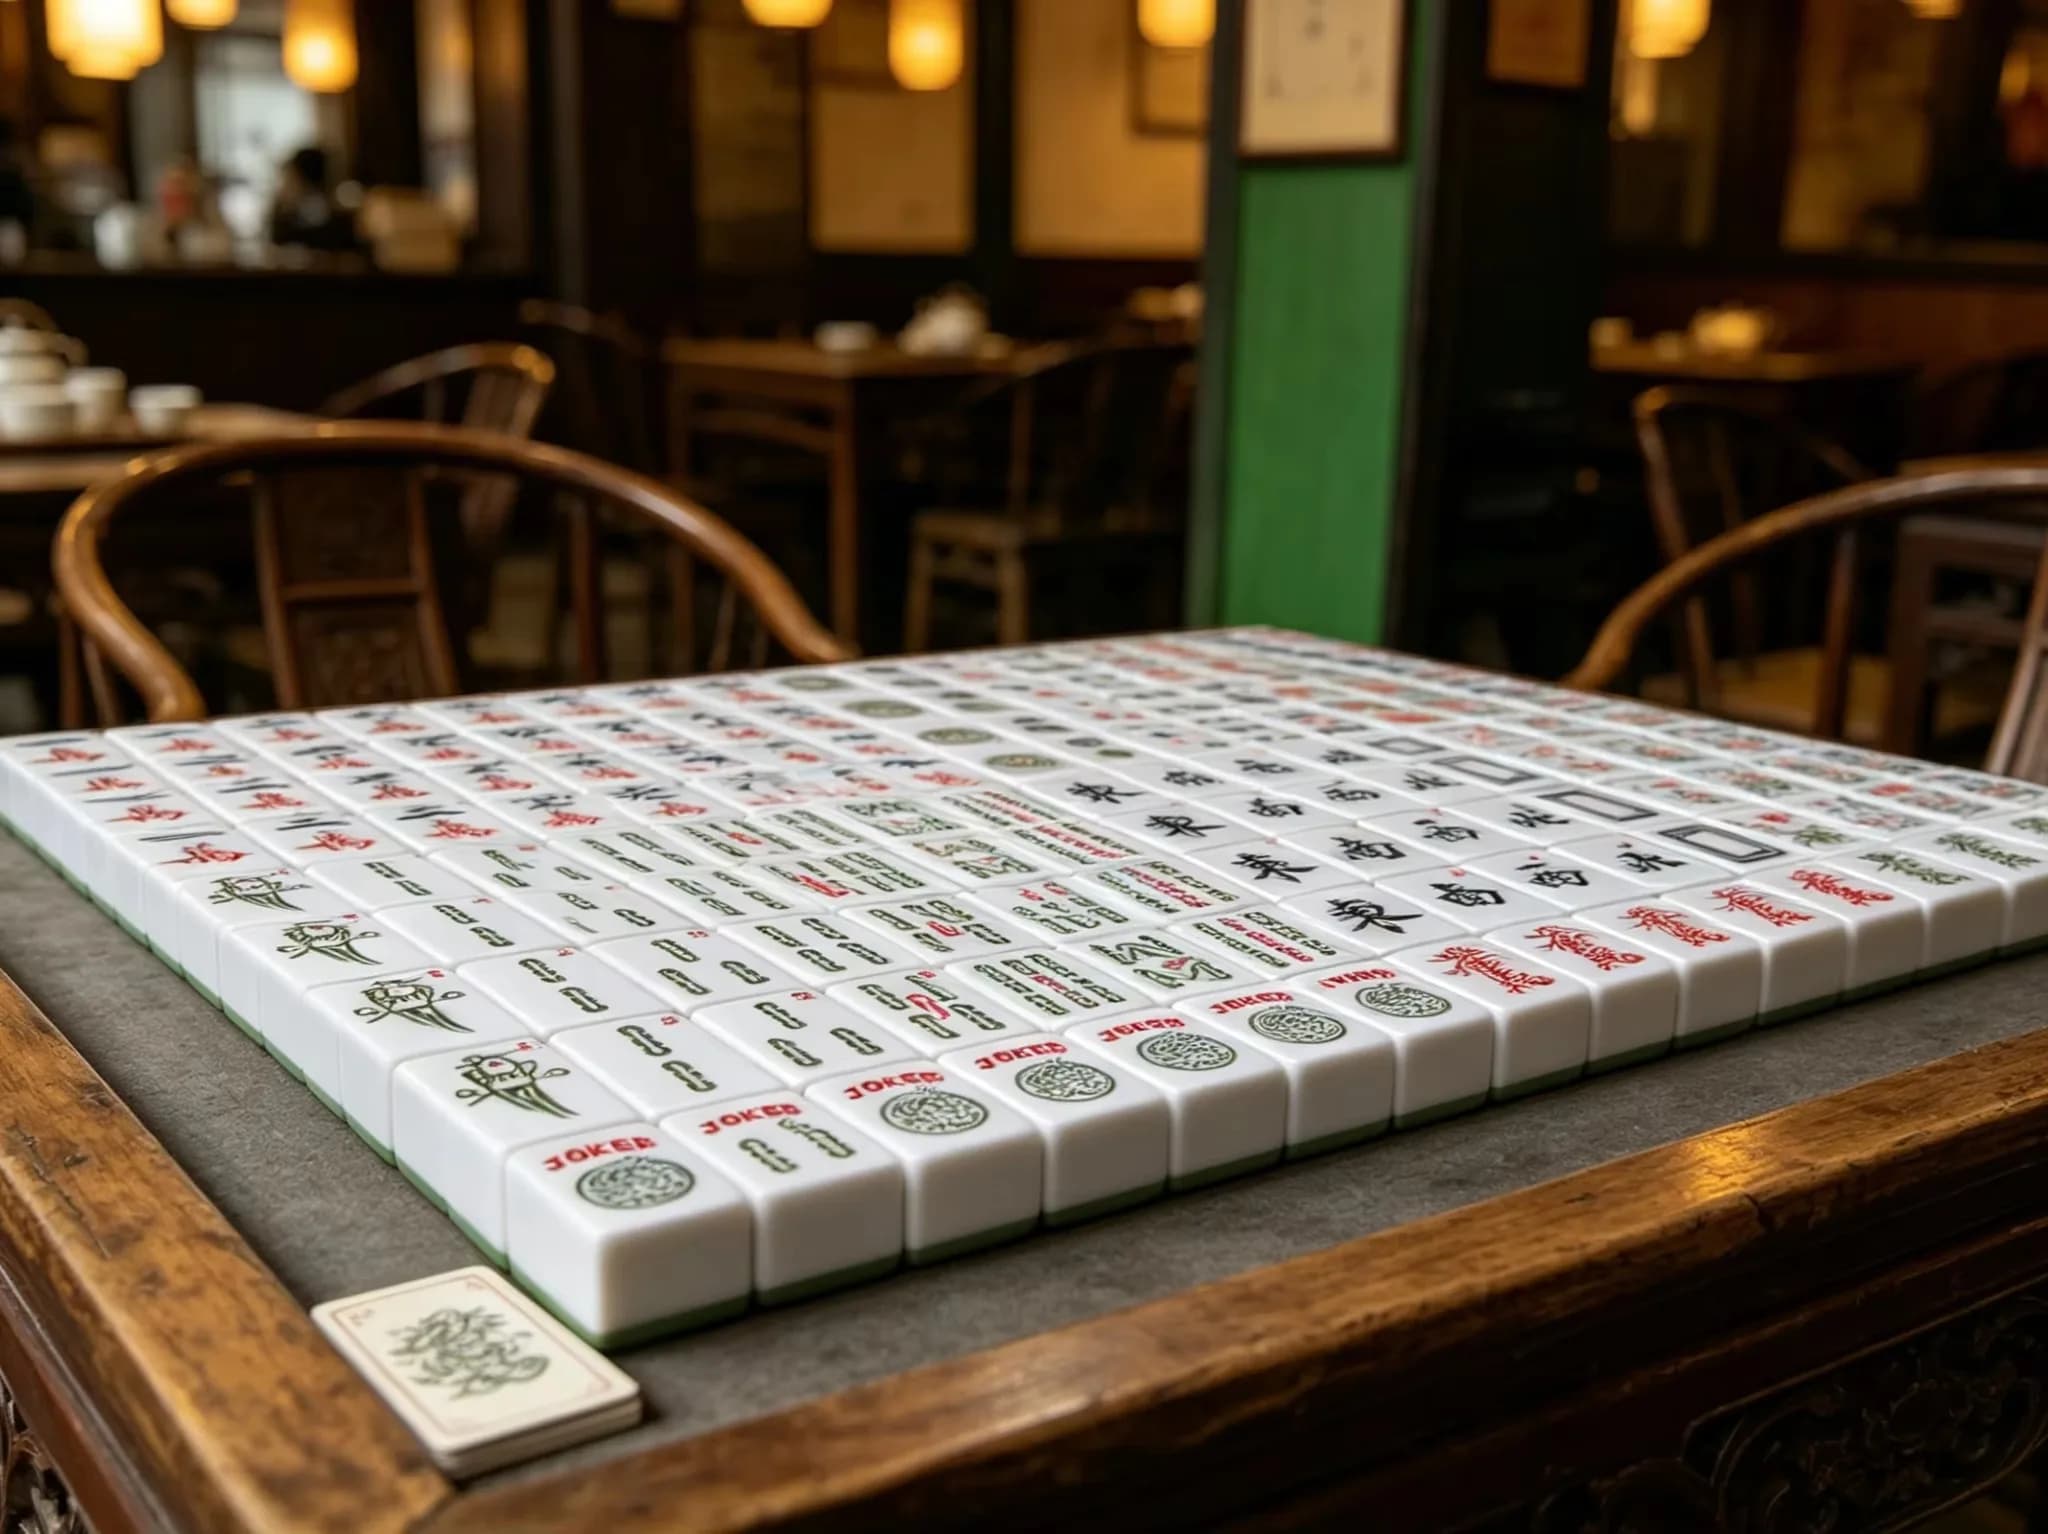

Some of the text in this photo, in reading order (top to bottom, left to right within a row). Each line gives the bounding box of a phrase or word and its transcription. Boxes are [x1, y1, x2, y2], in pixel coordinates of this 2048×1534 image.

[844, 1071, 945, 1100] JOKER
[700, 1103, 803, 1135] JOKER
[544, 1136, 657, 1171] JOKER
